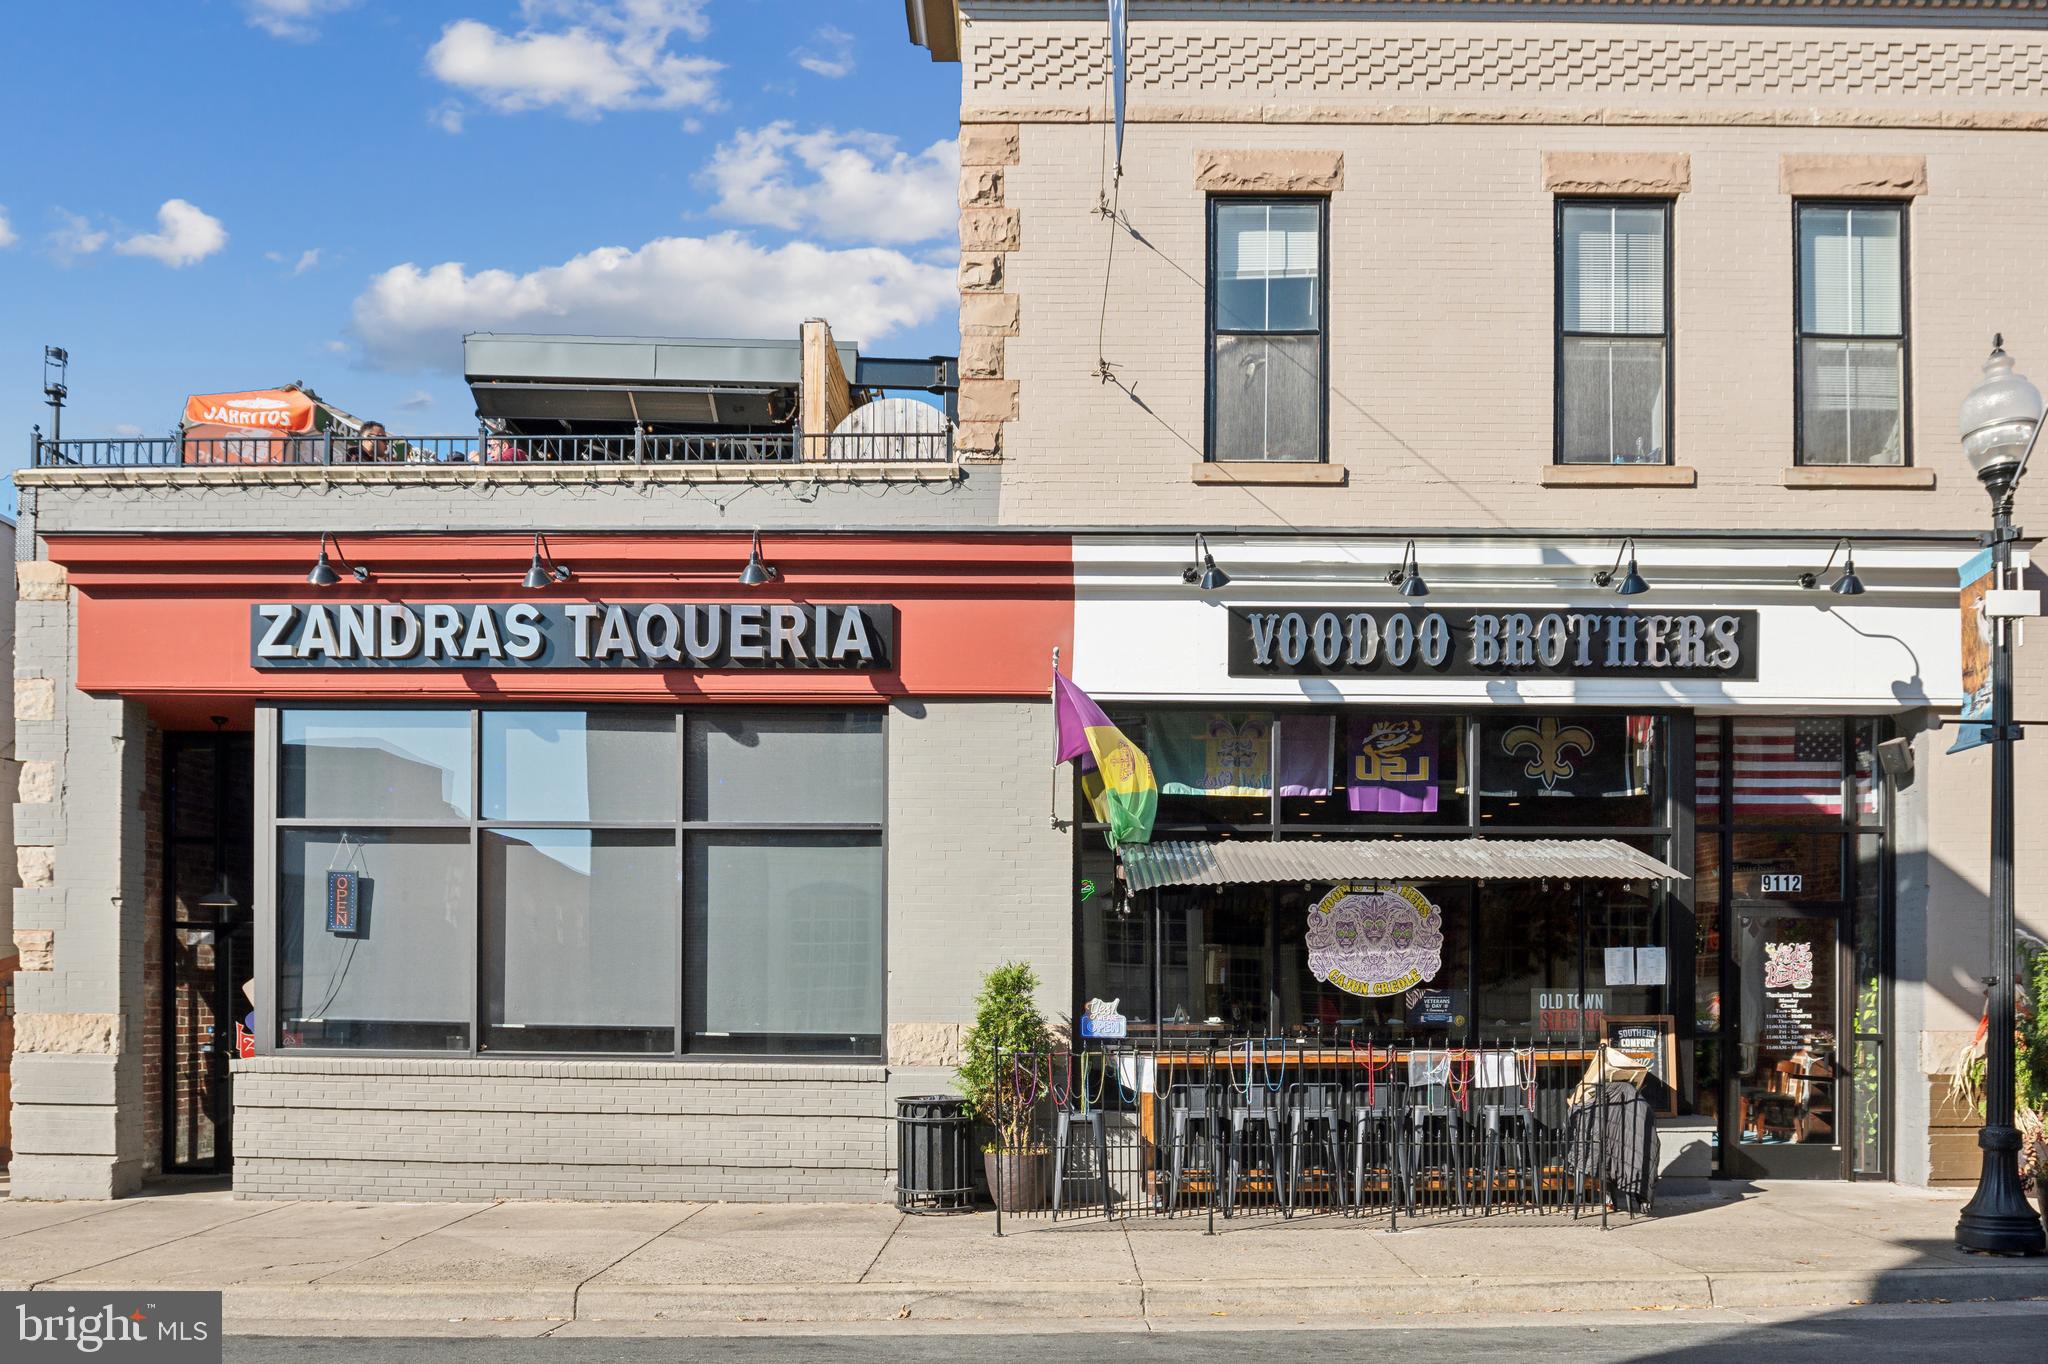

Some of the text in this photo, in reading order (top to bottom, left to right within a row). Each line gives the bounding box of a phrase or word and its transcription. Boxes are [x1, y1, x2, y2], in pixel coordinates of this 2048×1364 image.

[203, 405, 291, 427] JARRITOS
[257, 603, 874, 663] ZANDRAS TAQUERIA
[1247, 613, 1741, 669] VOODOO BROTHERS
[1763, 875, 1801, 891] 9112
[336, 876, 348, 926] OPEN
[1318, 884, 1432, 918] VOOD THERS
[1328, 968, 1422, 995] CAJUN CREOLE
[1539, 993, 1604, 1009] OLD TOWN
[1087, 1020, 1120, 1033] OPEN
[1618, 1028, 1657, 1039] SOUTHERN
[1620, 1038, 1656, 1048] COMFORT
